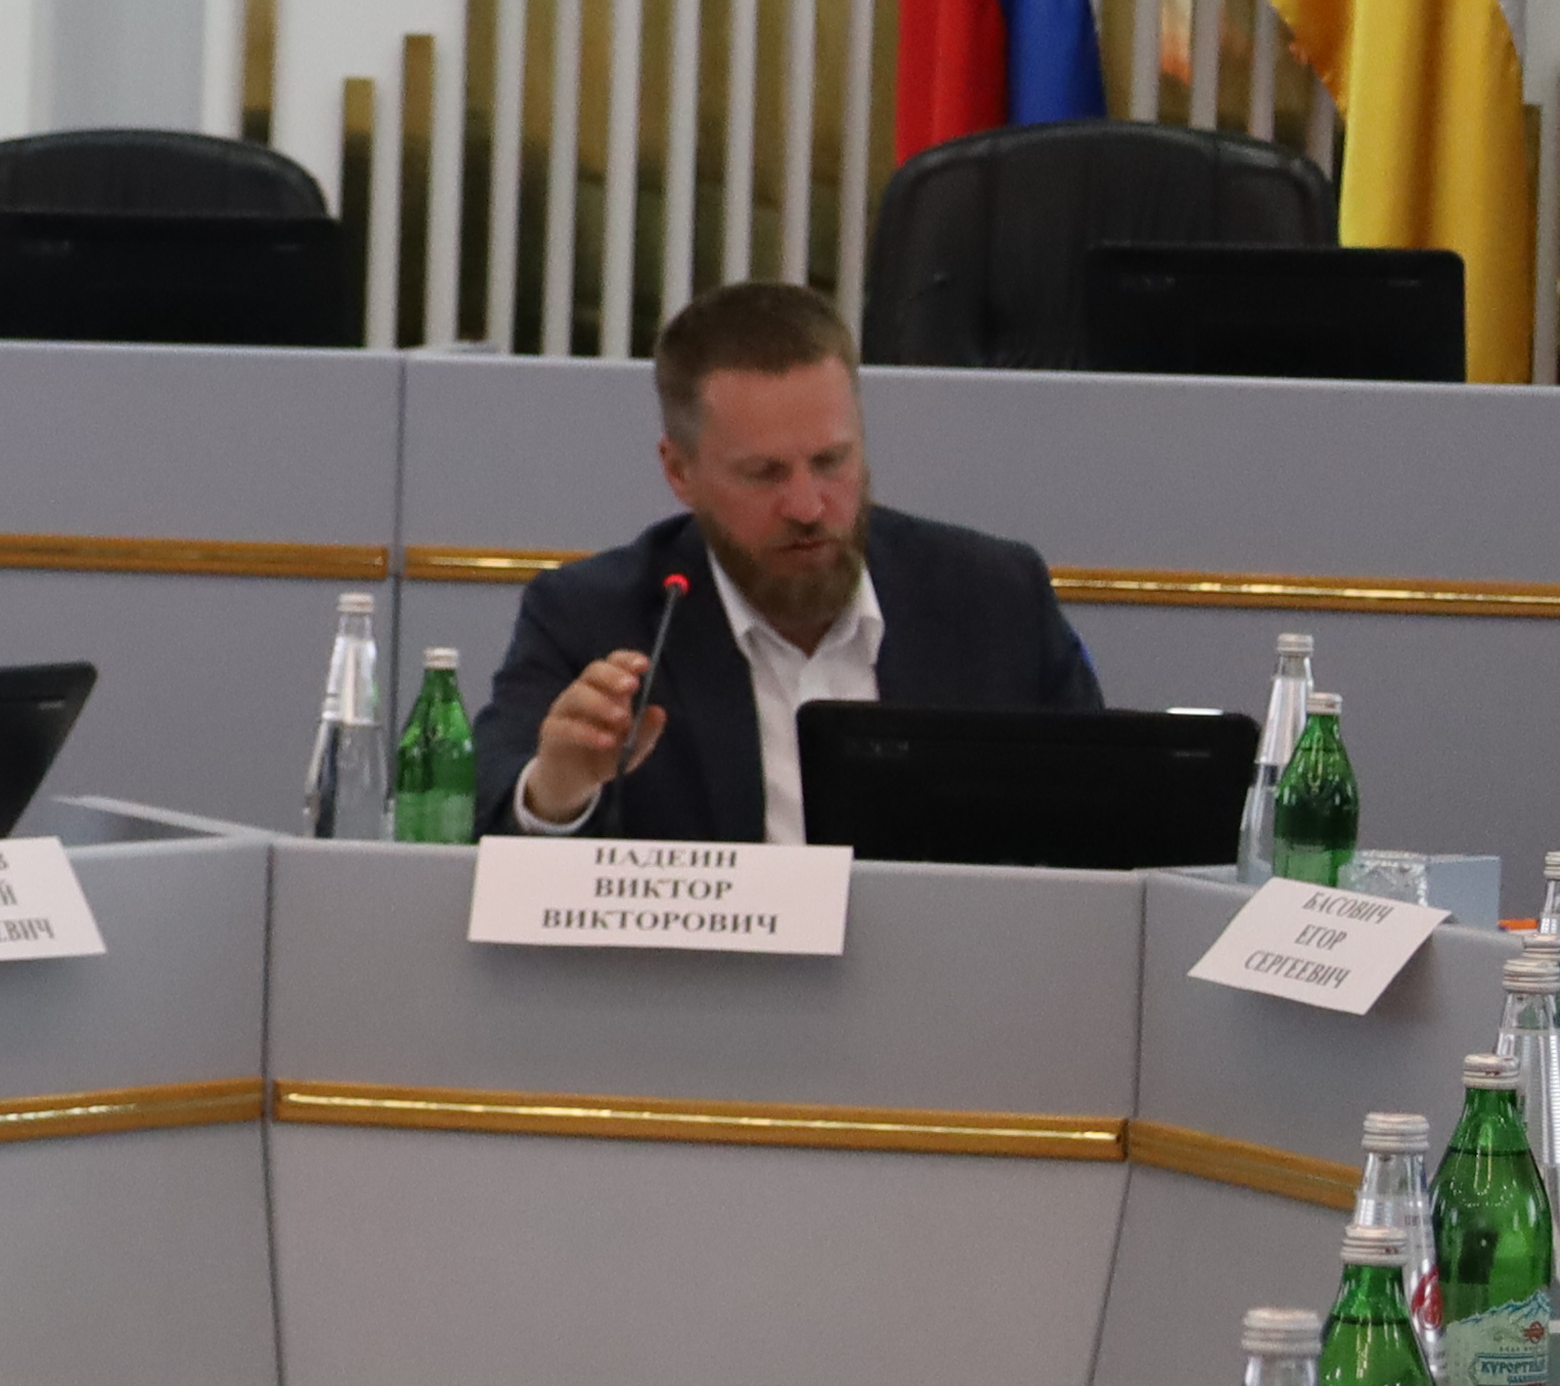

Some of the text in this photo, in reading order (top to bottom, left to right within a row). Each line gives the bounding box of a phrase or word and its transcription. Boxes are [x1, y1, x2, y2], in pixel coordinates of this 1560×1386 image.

[593, 846, 738, 869] НАДЕИН
[593, 877, 733, 899] ВИКТОР
[541, 908, 778, 934] ВИКТОРОВИЧ
[1294, 923, 1347, 951] ЕГОР
[1244, 949, 1352, 990] СЕРГЕЕВИЧ
